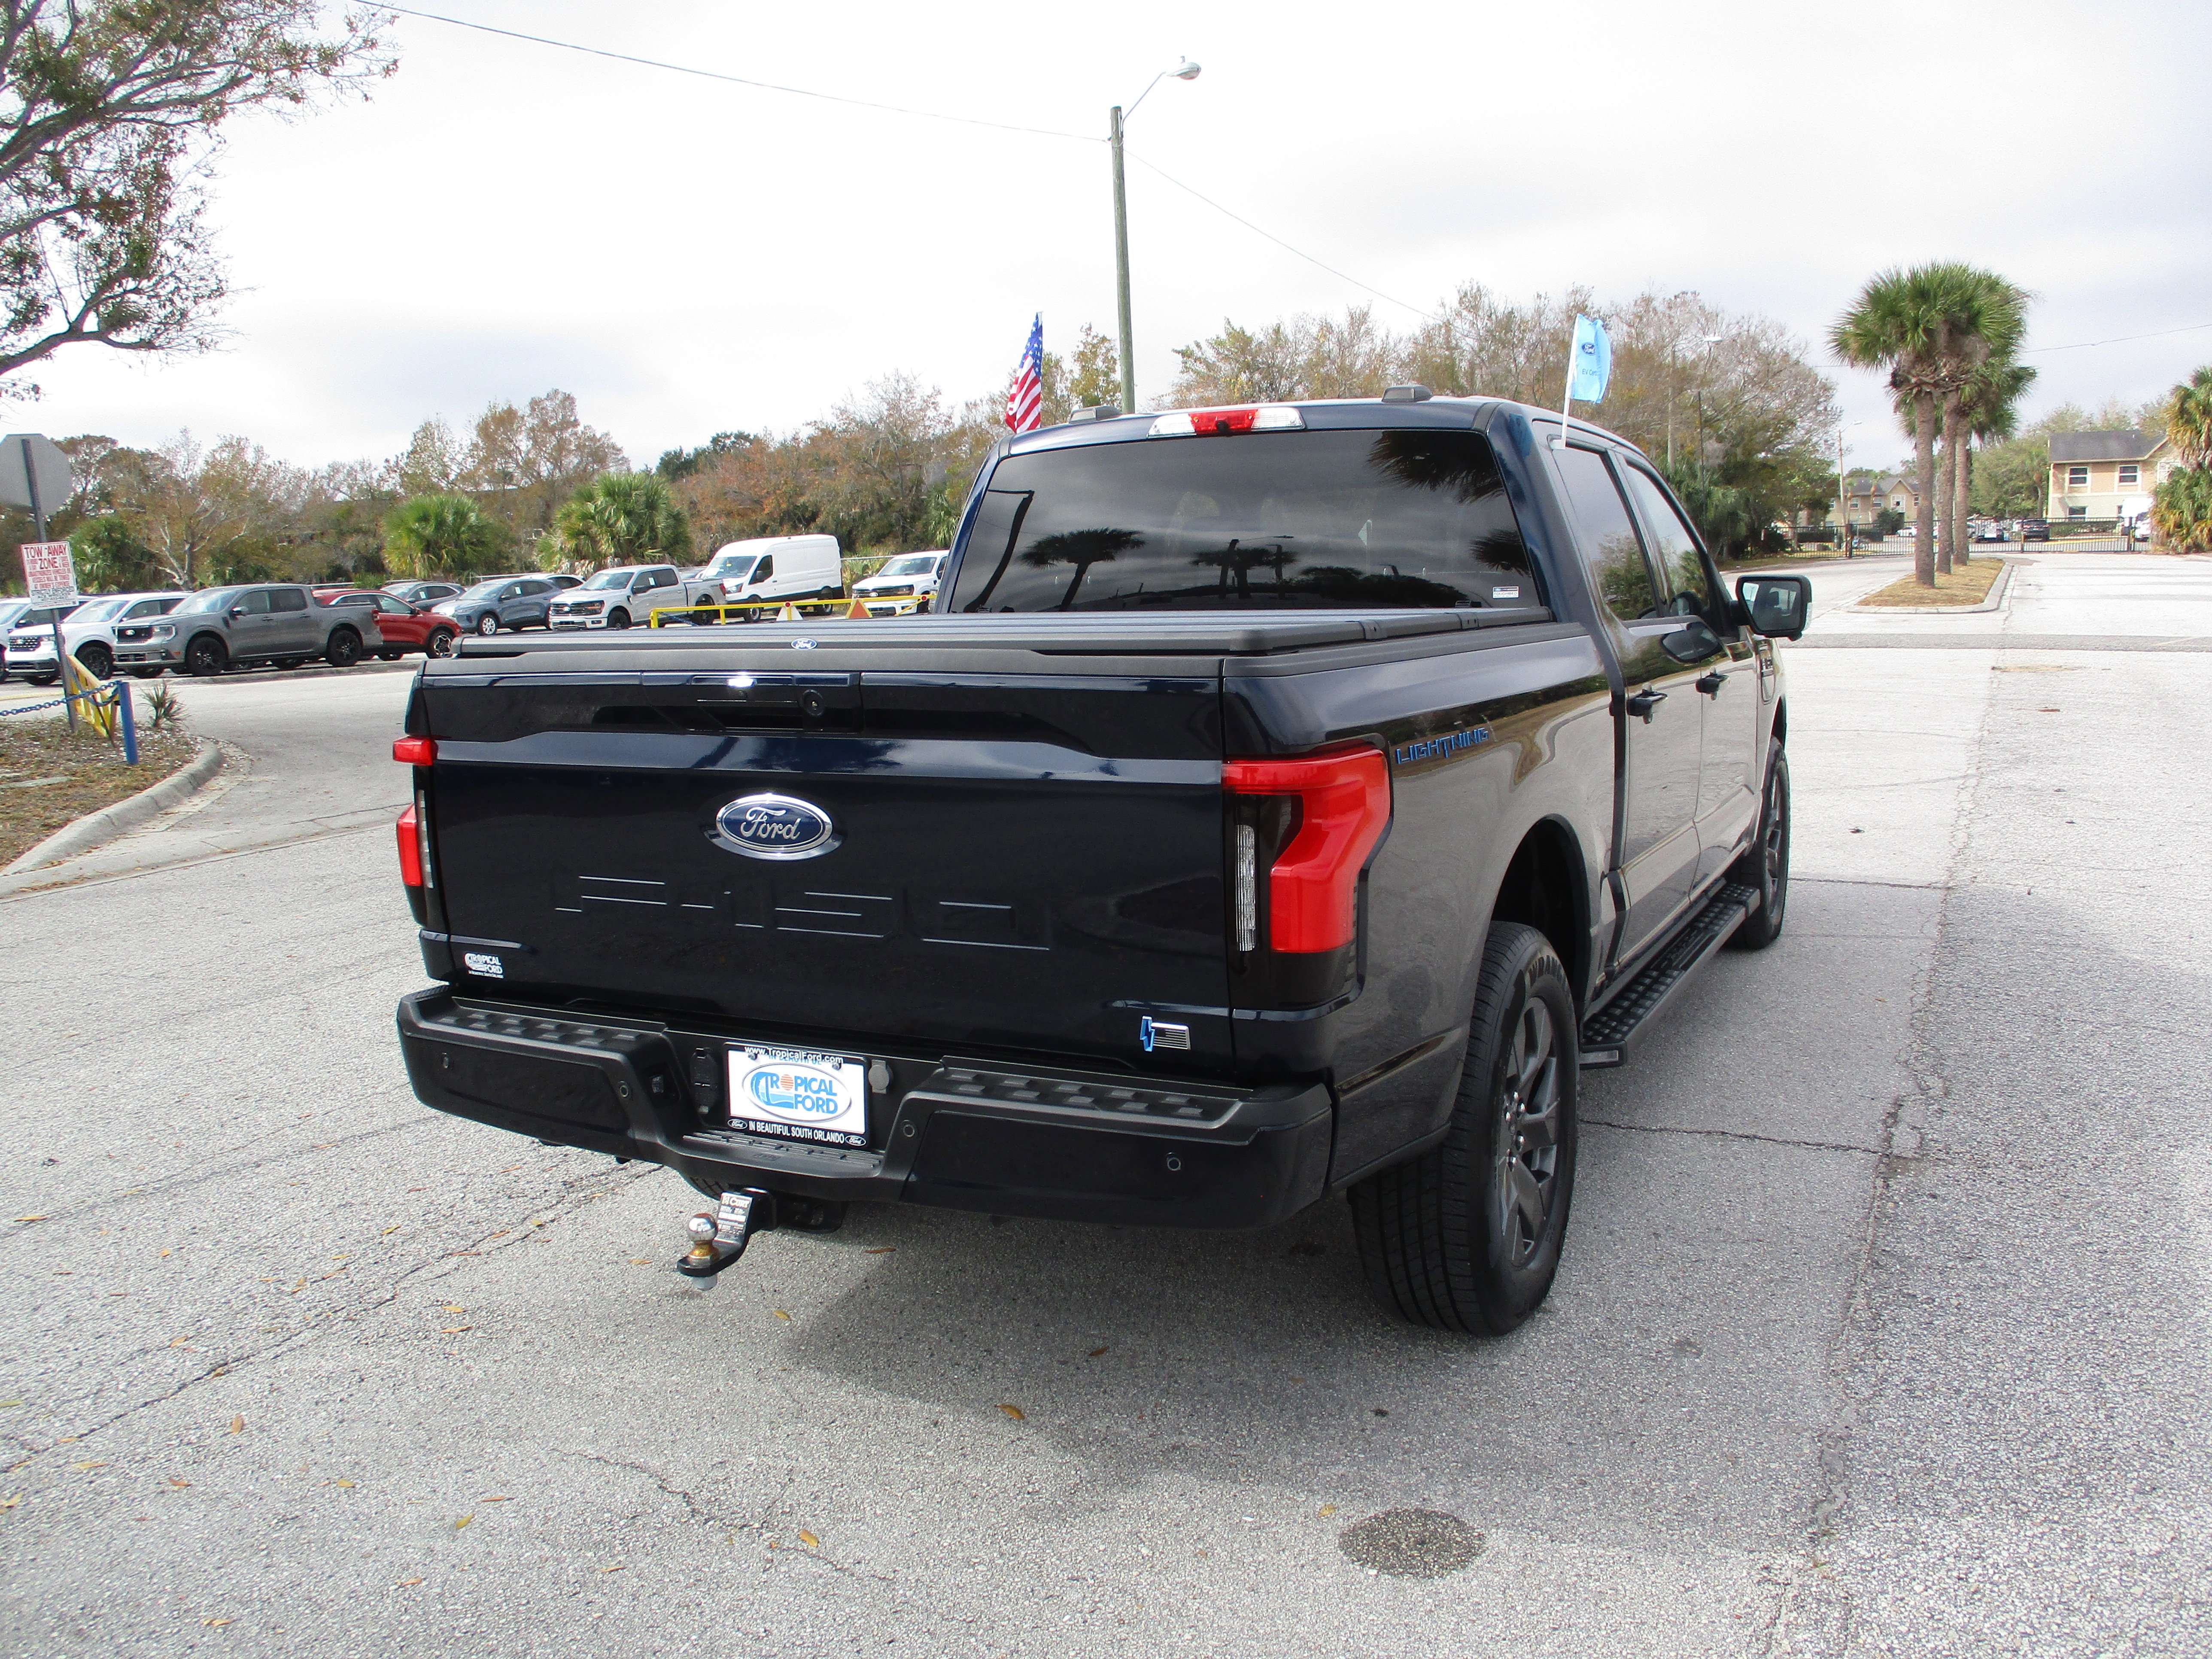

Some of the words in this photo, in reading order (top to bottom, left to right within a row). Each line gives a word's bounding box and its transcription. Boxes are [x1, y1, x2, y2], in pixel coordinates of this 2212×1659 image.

[24, 546, 43, 558] TOW
[39, 557, 58, 569] ZONE
[796, 640, 812, 648] Ford
[1396, 727, 1489, 764] LIGHTNING
[740, 806, 802, 840] Ford
[485, 964, 503, 974] FORD
[744, 1046, 844, 1063] www.TropicalFord.com
[794, 1094, 838, 1114] FORD
[731, 1120, 744, 1128] Ford
[749, 1121, 755, 1130] IN
[757, 1122, 790, 1136] BEAUTIFUL
[791, 1127, 812, 1139] SOUTH
[814, 1131, 845, 1144] ORLANDO
[849, 1136, 862, 1145] Ford
